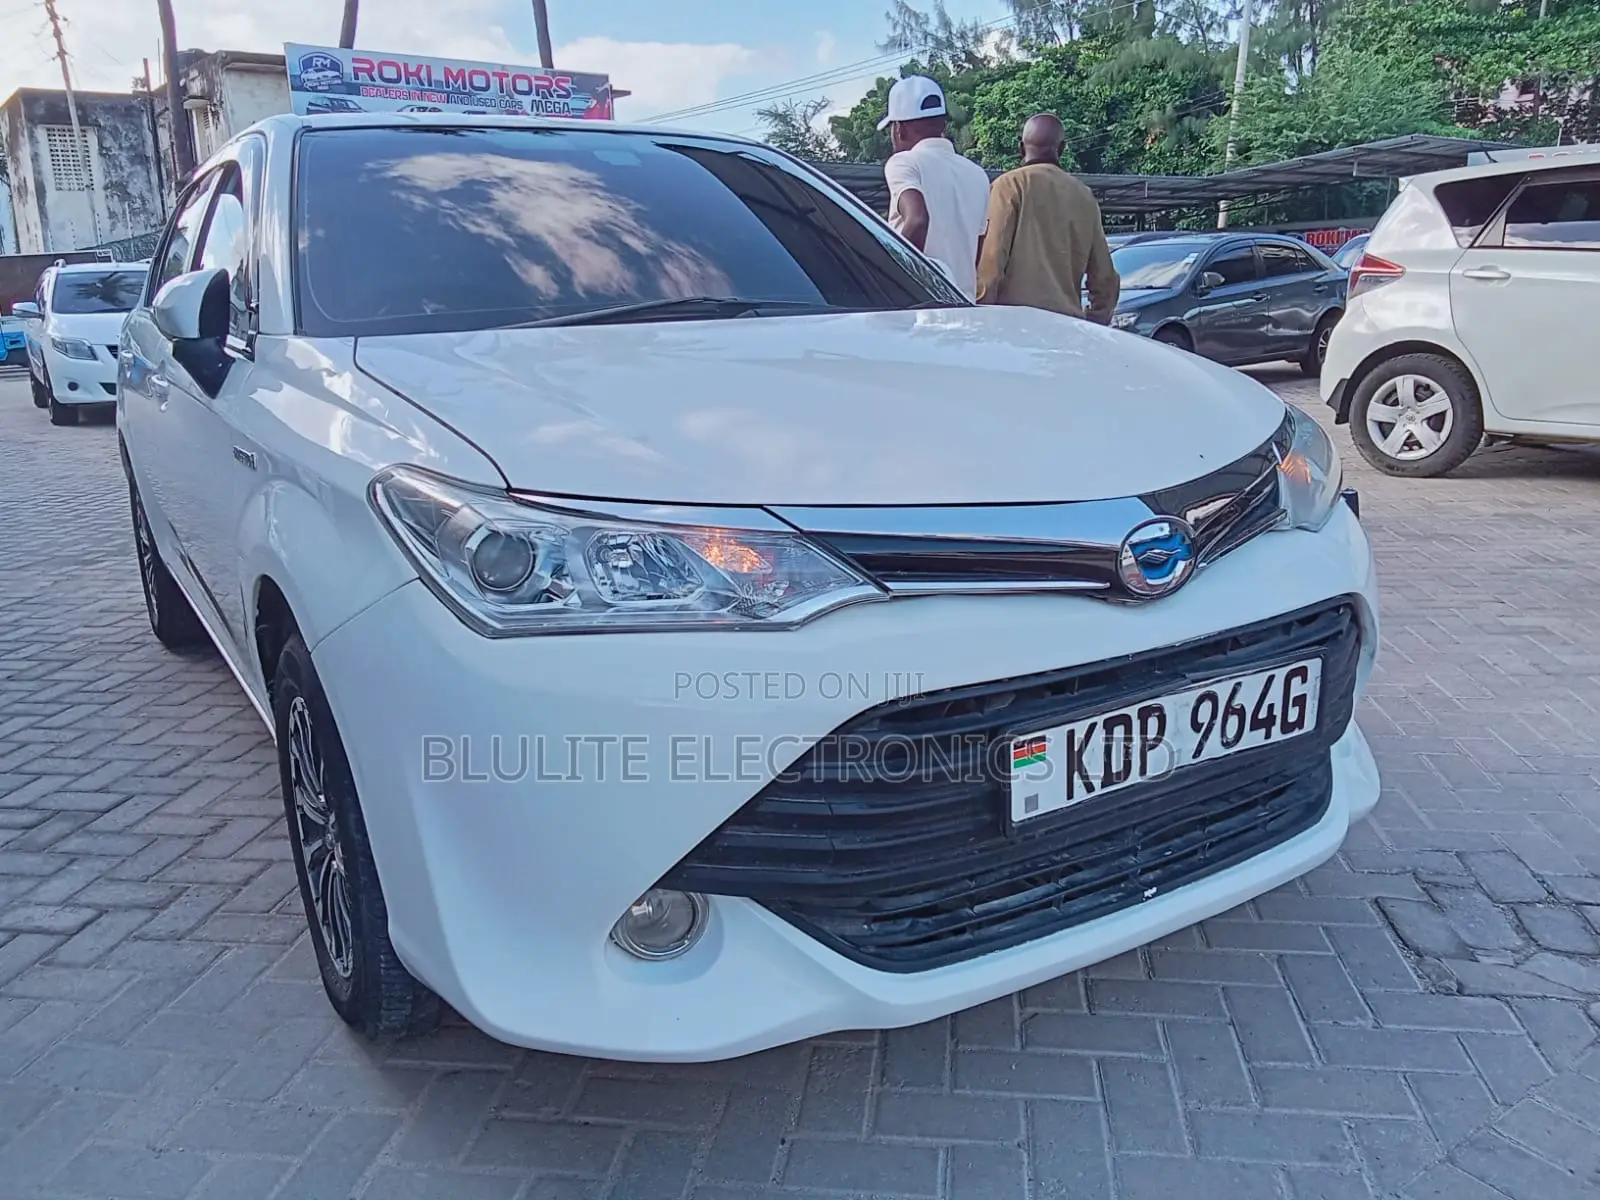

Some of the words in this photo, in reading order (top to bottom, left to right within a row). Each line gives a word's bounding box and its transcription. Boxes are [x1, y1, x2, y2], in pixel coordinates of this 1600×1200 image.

[352, 57, 434, 88] ROKI
[443, 66, 572, 100] MOTORS
[361, 87, 409, 101] DEALERS
[411, 91, 422, 102] IN
[423, 92, 448, 104] NEW
[449, 94, 471, 106] AND
[474, 96, 497, 108] USED
[500, 98, 524, 110] CARS
[531, 99, 572, 115] MEGA
[1066, 703, 1167, 801] KDP
[1190, 665, 1309, 760] 964G
